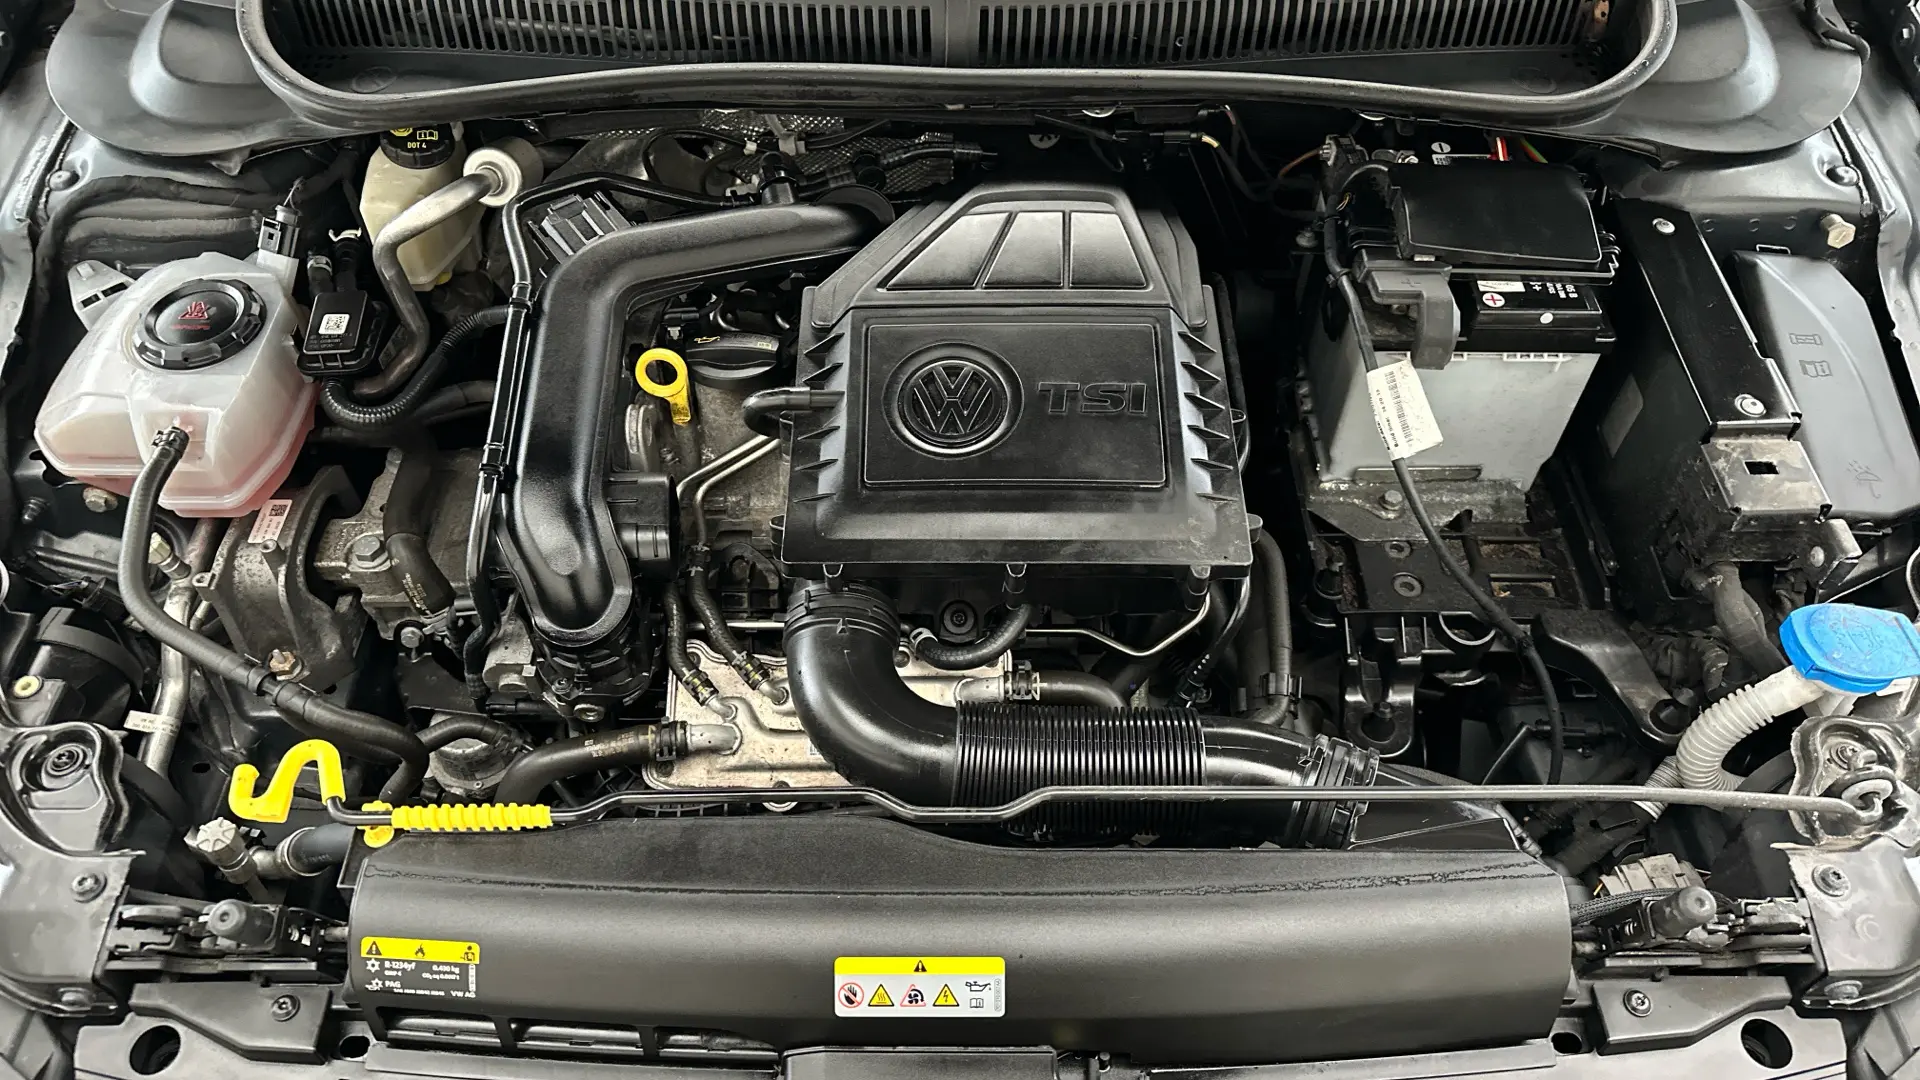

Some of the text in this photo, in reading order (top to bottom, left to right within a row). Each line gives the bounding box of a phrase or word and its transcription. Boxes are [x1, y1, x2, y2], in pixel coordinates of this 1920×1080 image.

[407, 141, 427, 149] DOT 4
[1038, 381, 1149, 415] TSI
[384, 960, 416, 971] R-1234yf
[451, 965, 460, 974] kg
[384, 980, 401, 988] PAG
